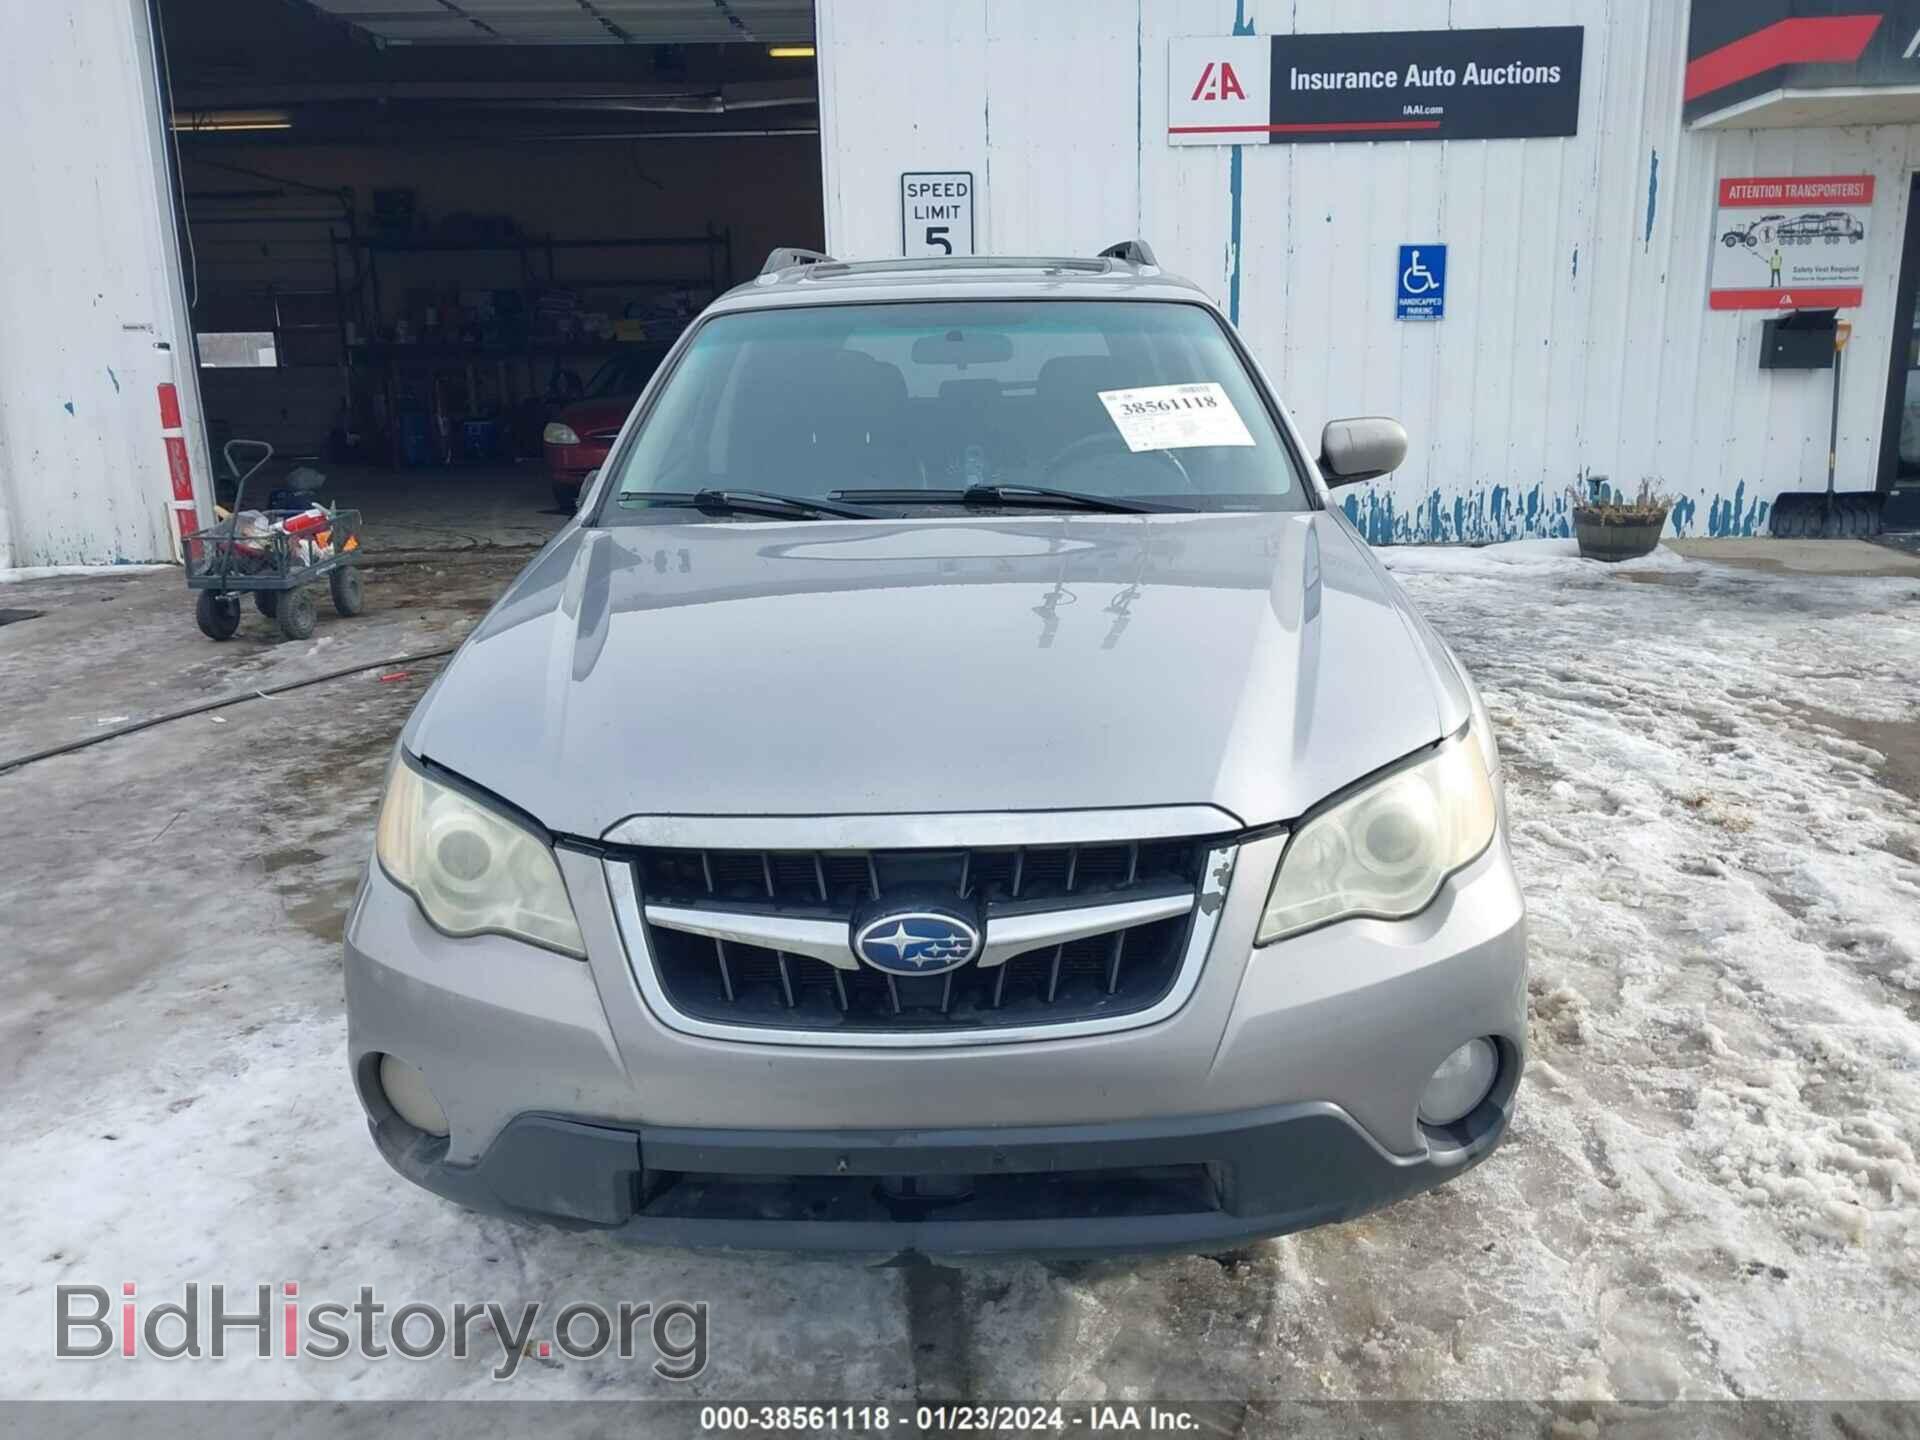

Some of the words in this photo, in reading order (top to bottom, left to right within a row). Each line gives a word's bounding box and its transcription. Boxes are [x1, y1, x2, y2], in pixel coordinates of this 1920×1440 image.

[1290, 67, 1398, 90] Insurance
[1404, 64, 1456, 87] Auto
[1462, 61, 1562, 86] Auctions
[1402, 105, 1444, 116] IAAI.com
[907, 182, 968, 198] SPEED
[1728, 184, 1783, 200] ATTENTION
[1785, 182, 1865, 199] TRANSPORTERS!
[914, 204, 961, 220] LIMIT
[926, 226, 953, 256] 5
[1120, 395, 1218, 416] 38561118
